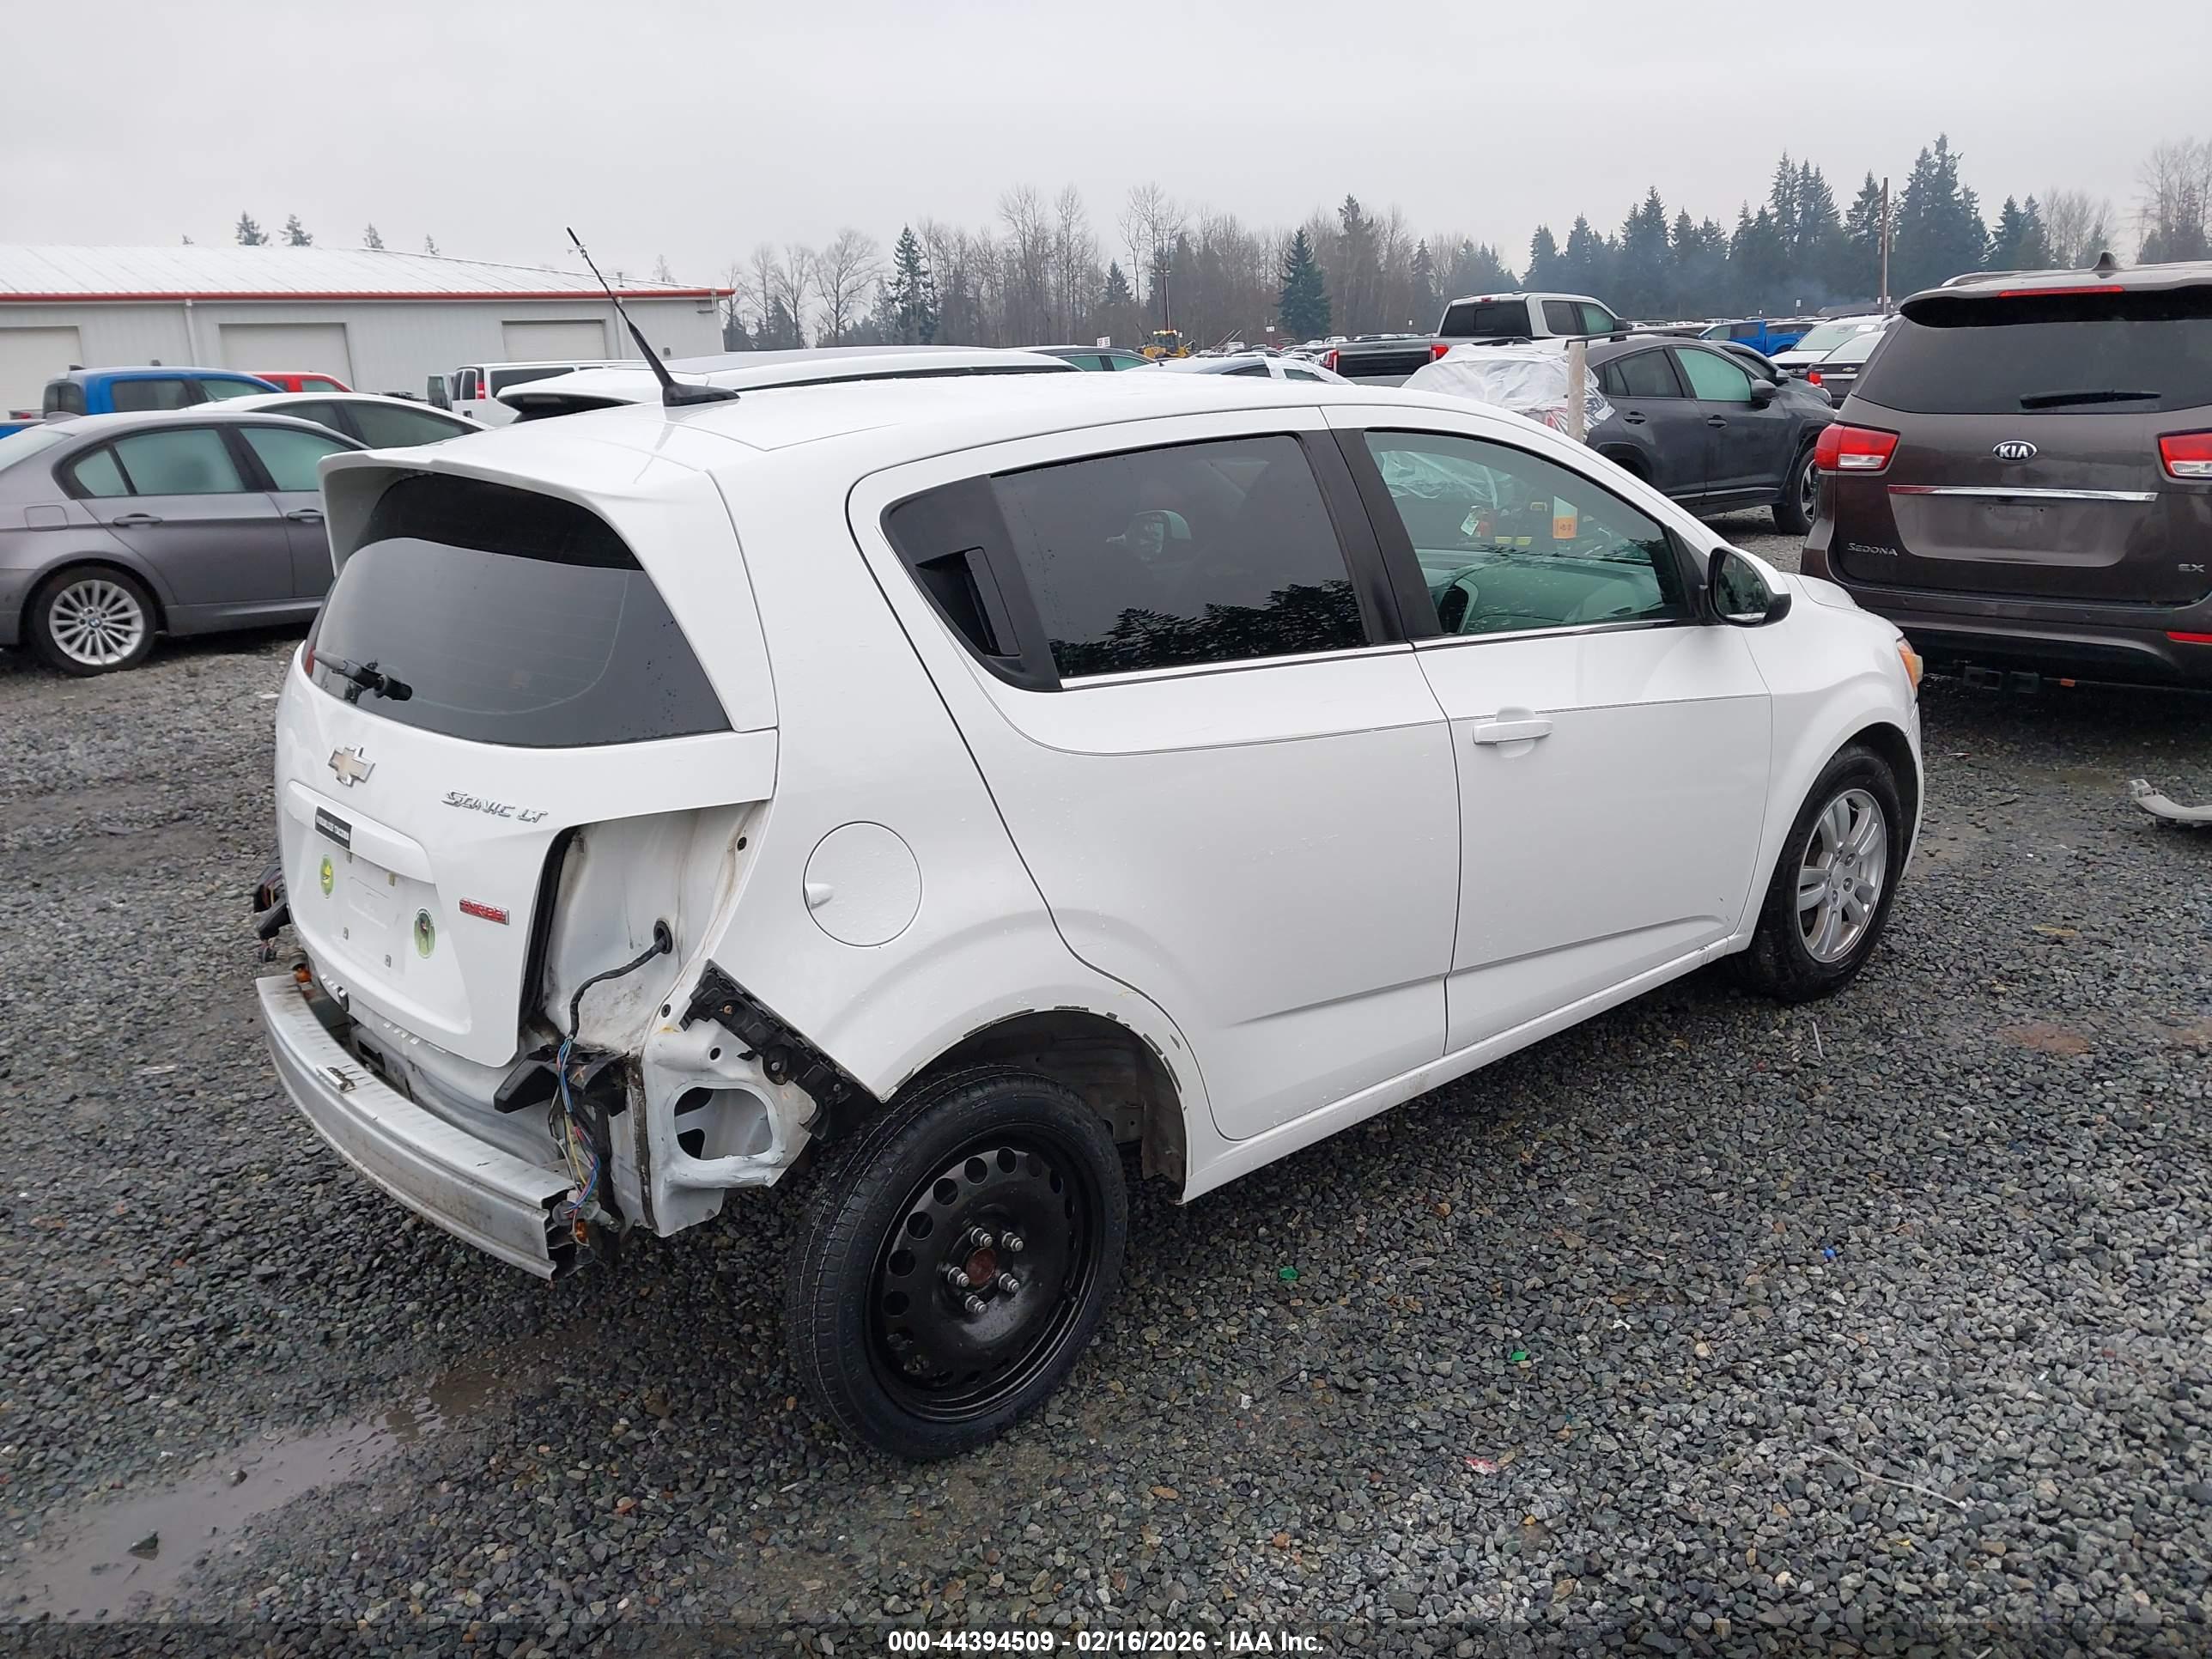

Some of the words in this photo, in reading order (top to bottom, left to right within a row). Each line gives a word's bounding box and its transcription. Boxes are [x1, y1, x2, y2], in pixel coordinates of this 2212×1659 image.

[1999, 445, 2028, 458] KIA
[1847, 543, 1898, 556] SEDONA
[2178, 563, 2205, 573] EX
[516, 809, 549, 823] LT
